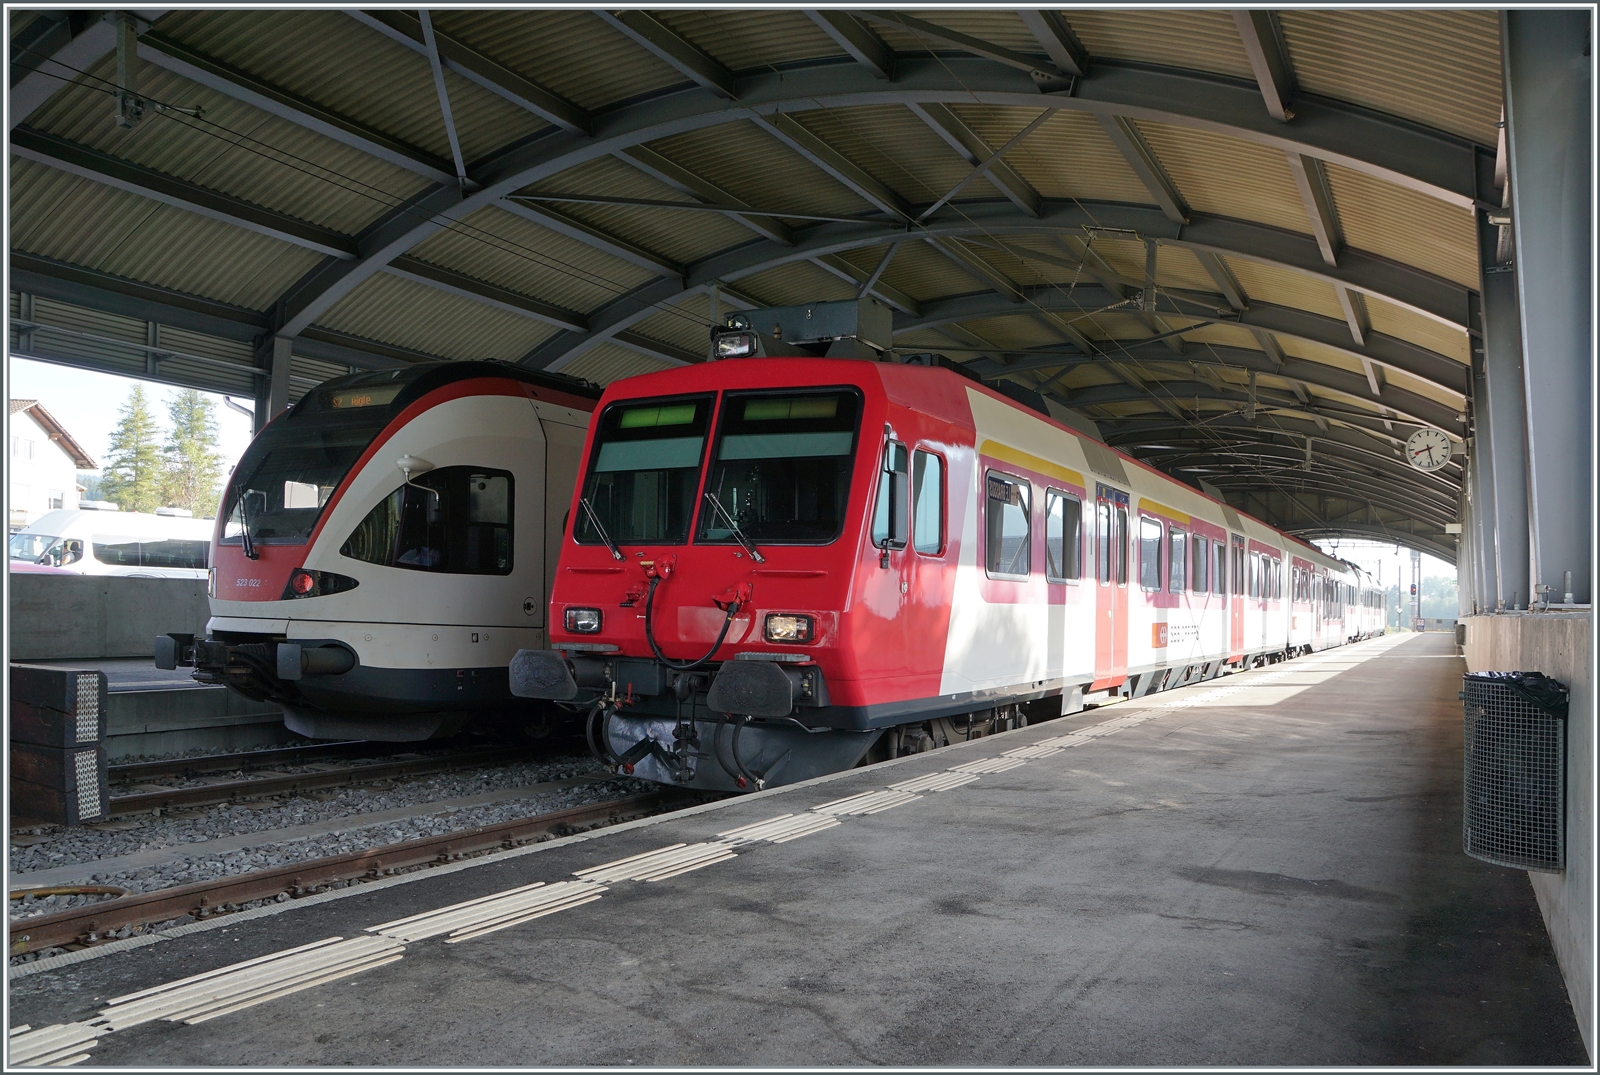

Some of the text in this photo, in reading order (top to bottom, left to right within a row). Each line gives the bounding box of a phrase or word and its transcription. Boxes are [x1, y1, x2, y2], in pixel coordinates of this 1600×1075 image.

[333, 397, 343, 408] S2
[236, 578, 261, 587] 523 022
